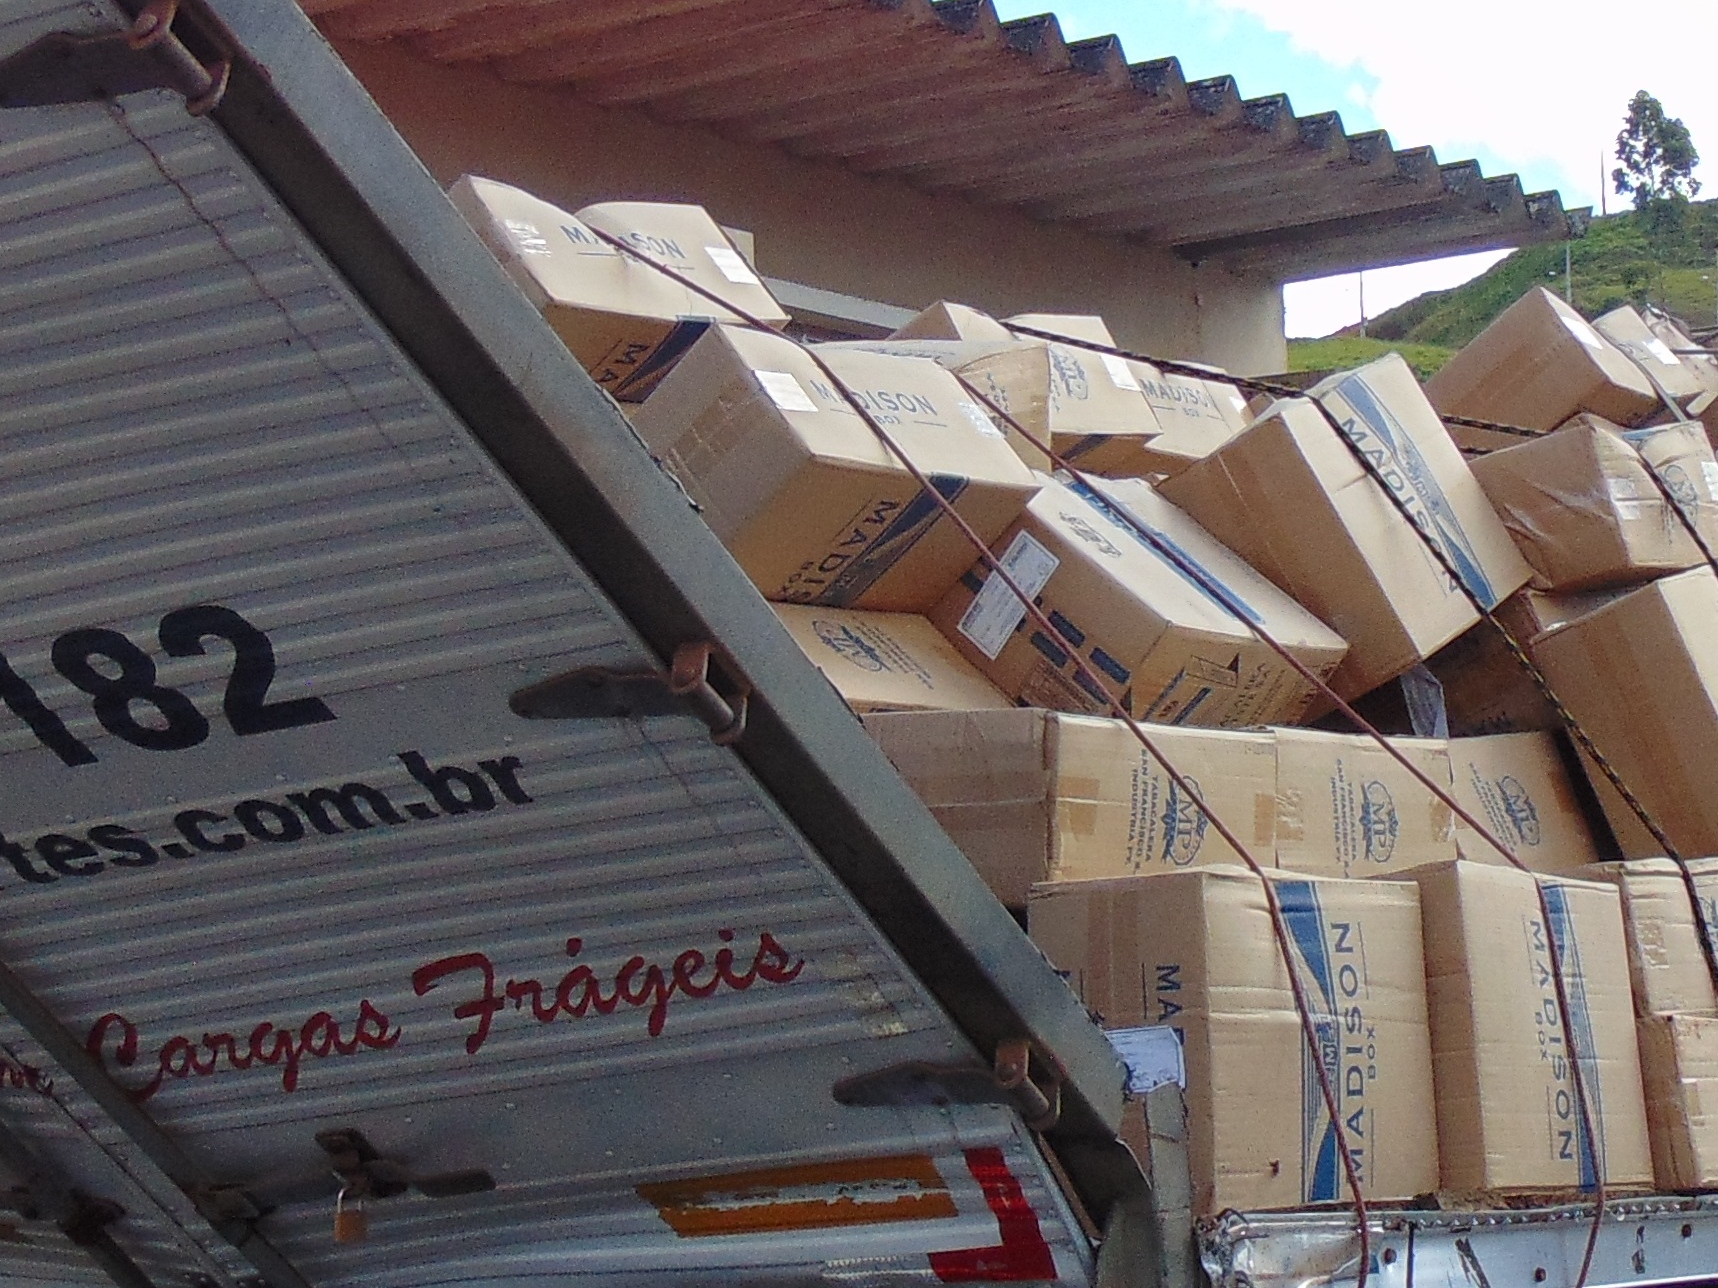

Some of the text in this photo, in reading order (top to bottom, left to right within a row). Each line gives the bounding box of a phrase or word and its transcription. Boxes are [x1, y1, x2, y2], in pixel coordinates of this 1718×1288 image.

[810, 379, 938, 416] MDISON
[1145, 774, 1159, 862] TABACALERA
[86, 1000, 402, 1103] Cargas
[413, 928, 805, 1054] Frágeis
[1331, 922, 1365, 1184] MADISON
[1366, 1025, 1377, 1081] BOX
[1529, 920, 1574, 1160] MADISON
